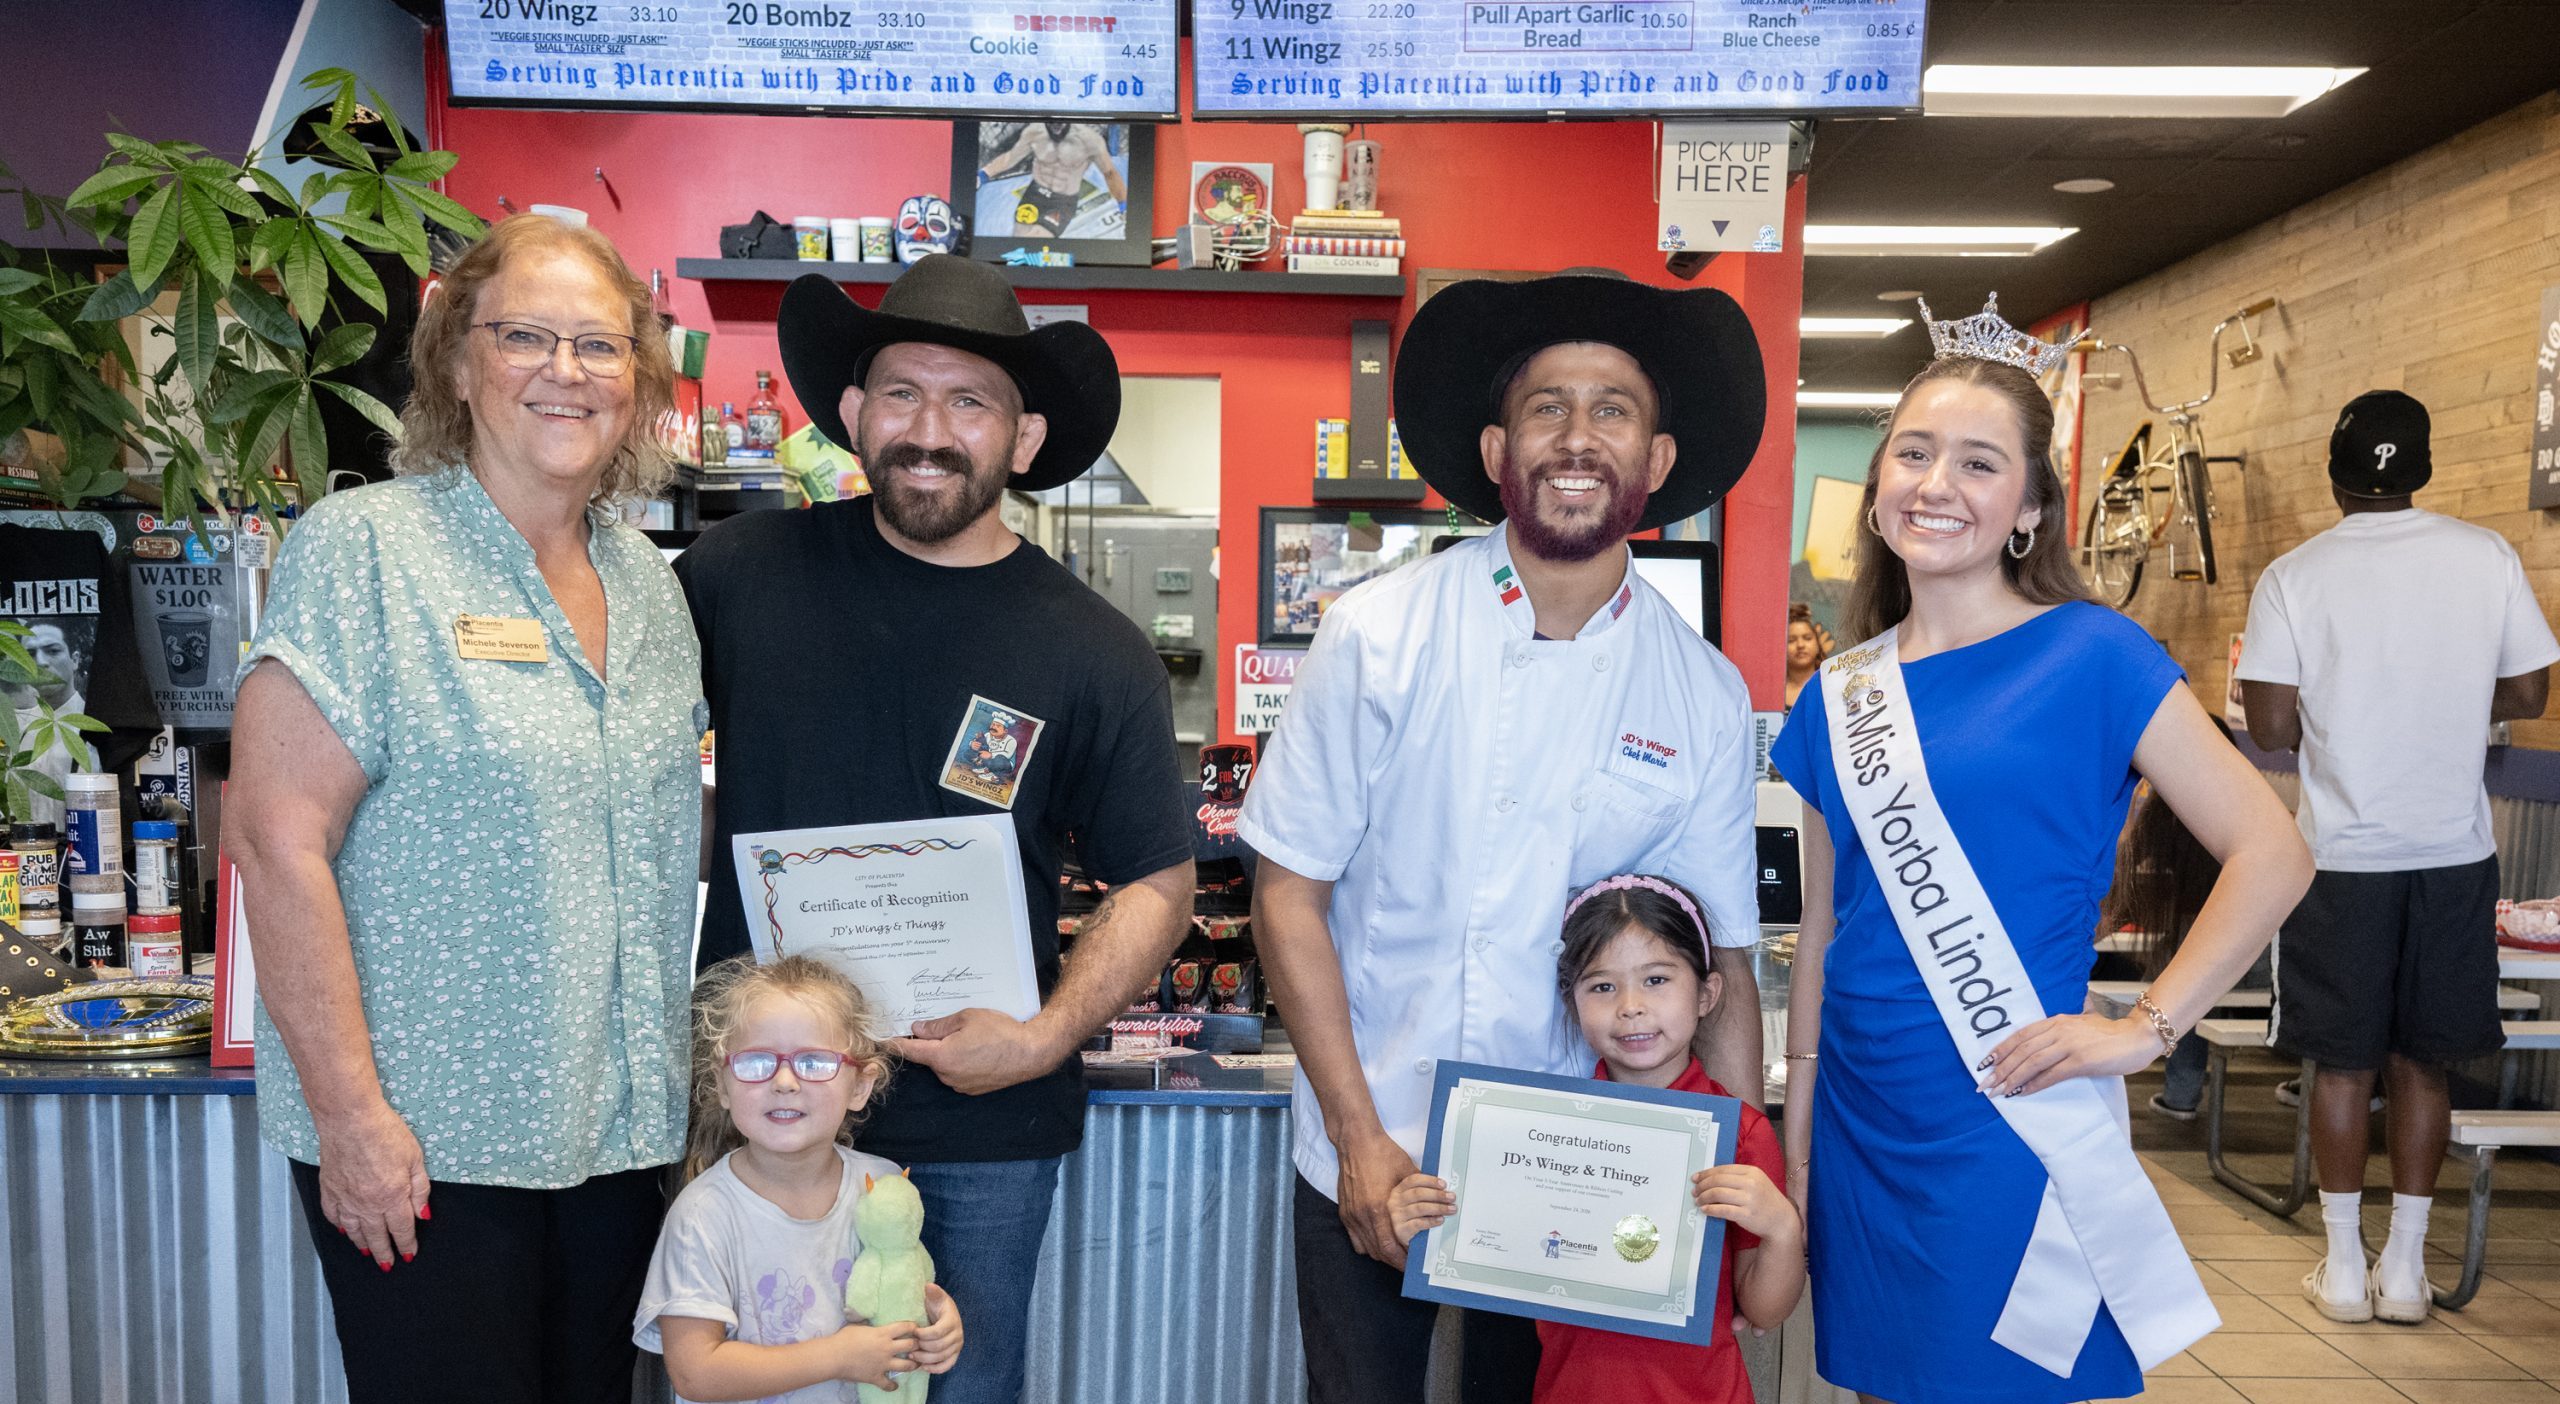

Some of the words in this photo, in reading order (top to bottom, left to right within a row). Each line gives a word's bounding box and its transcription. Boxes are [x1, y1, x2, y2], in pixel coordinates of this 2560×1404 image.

[480, 0, 510, 21] 20
[513, 0, 598, 26] Wingz
[630, 7, 678, 23] 33.10
[727, 3, 758, 26] 20
[766, 3, 852, 28] Bombz
[878, 12, 925, 28] 33.10
[1231, 0, 1246, 20] 9
[1255, 0, 1332, 24] Wingz
[1368, 4, 1415, 19] 22.20
[1473, 5, 1508, 24] Pull
[1515, 6, 1571, 27] Apart
[1577, 5, 1635, 24] Garlic
[1641, 13, 1688, 28] 10.50
[1749, 13, 1797, 28] Ranch
[1014, 15, 1117, 33] DESSERT
[532, 33, 562, 43] STICKS
[564, 33, 611, 43] INCLUDED
[617, 34, 637, 44] JUST
[779, 38, 809, 48] STICKS
[811, 39, 856, 49] INCLUDED
[864, 40, 884, 49] JUST
[1524, 29, 1582, 48] Bread
[1723, 33, 1758, 48] Blue
[1763, 32, 1820, 47] Cheese
[1866, 23, 1900, 38] 0.85
[534, 43, 564, 53] SMALL
[607, 44, 625, 54] SIZE
[781, 49, 809, 59] SMALL
[853, 51, 872, 60] SIZE
[969, 36, 1038, 55] Cookie
[1122, 44, 1157, 59] 4.45
[1226, 37, 1254, 59] 11
[1263, 37, 1341, 64] Wingz
[1368, 42, 1415, 57] 25.50
[485, 58, 597, 88] Serving
[614, 61, 744, 90] Placentia
[762, 65, 819, 93] with
[837, 67, 912, 95] Pride
[931, 71, 976, 94] and
[993, 71, 1060, 95] Good
[1077, 74, 1144, 98] Food
[1231, 71, 1342, 99] Serving
[1358, 71, 1487, 99] Placentia
[1505, 70, 1562, 97] with
[1578, 69, 1656, 97] Pride
[1674, 70, 1719, 94] and
[1737, 69, 1805, 93] Good
[1821, 69, 1889, 94] Food
[1678, 141, 1733, 162] PICK
[1743, 142, 1771, 162] UP
[1677, 164, 1770, 193] HERE
[1333, 258, 1380, 268] COOKING
[2374, 443, 2397, 470] P
[155, 520, 185, 529] LOAL
[205, 520, 233, 529] LOCL
[138, 566, 223, 586] WATER
[156, 589, 212, 608] $1.00
[471, 619, 503, 627] Placentia
[463, 639, 497, 648] Michele
[499, 640, 540, 650] Severson
[1245, 655, 1304, 682] QUA
[155, 690, 187, 700] FREE
[190, 691, 224, 700] WITH
[1241, 714, 1256, 728] IN
[1621, 733, 1644, 747] JD's
[1646, 739, 1677, 757] Wingz
[1622, 745, 1641, 761] Chef
[1755, 718, 1767, 771] EMPLOYEES
[957, 773, 974, 785] JD'S
[975, 780, 1004, 795] WINGZ
[1201, 763, 1218, 791] 2
[1219, 771, 1233, 783] FOR
[1233, 763, 1252, 790] $7
[26, 853, 53, 864] RUB
[1846, 704, 1895, 786] Miss
[1871, 781, 1950, 917] Yorba
[1927, 914, 2013, 1039] Linda
[800, 898, 867, 913] Certificate
[871, 894, 884, 908] of
[887, 890, 969, 908] Recognition
[83, 929, 110, 941] Aw
[830, 925, 853, 938] JD's
[855, 924, 891, 935] Wingz
[894, 922, 902, 931] &
[905, 919, 947, 931] Thingz
[83, 945, 113, 958] Shit
[1528, 1129, 1631, 1154] Congratulations
[1501, 1151, 1532, 1167] JD's
[1536, 1156, 1579, 1176] Wingz
[1583, 1164, 1596, 1176] &
[1600, 1166, 1650, 1187] Thingz
[1560, 1239, 1598, 1252] Placentia
